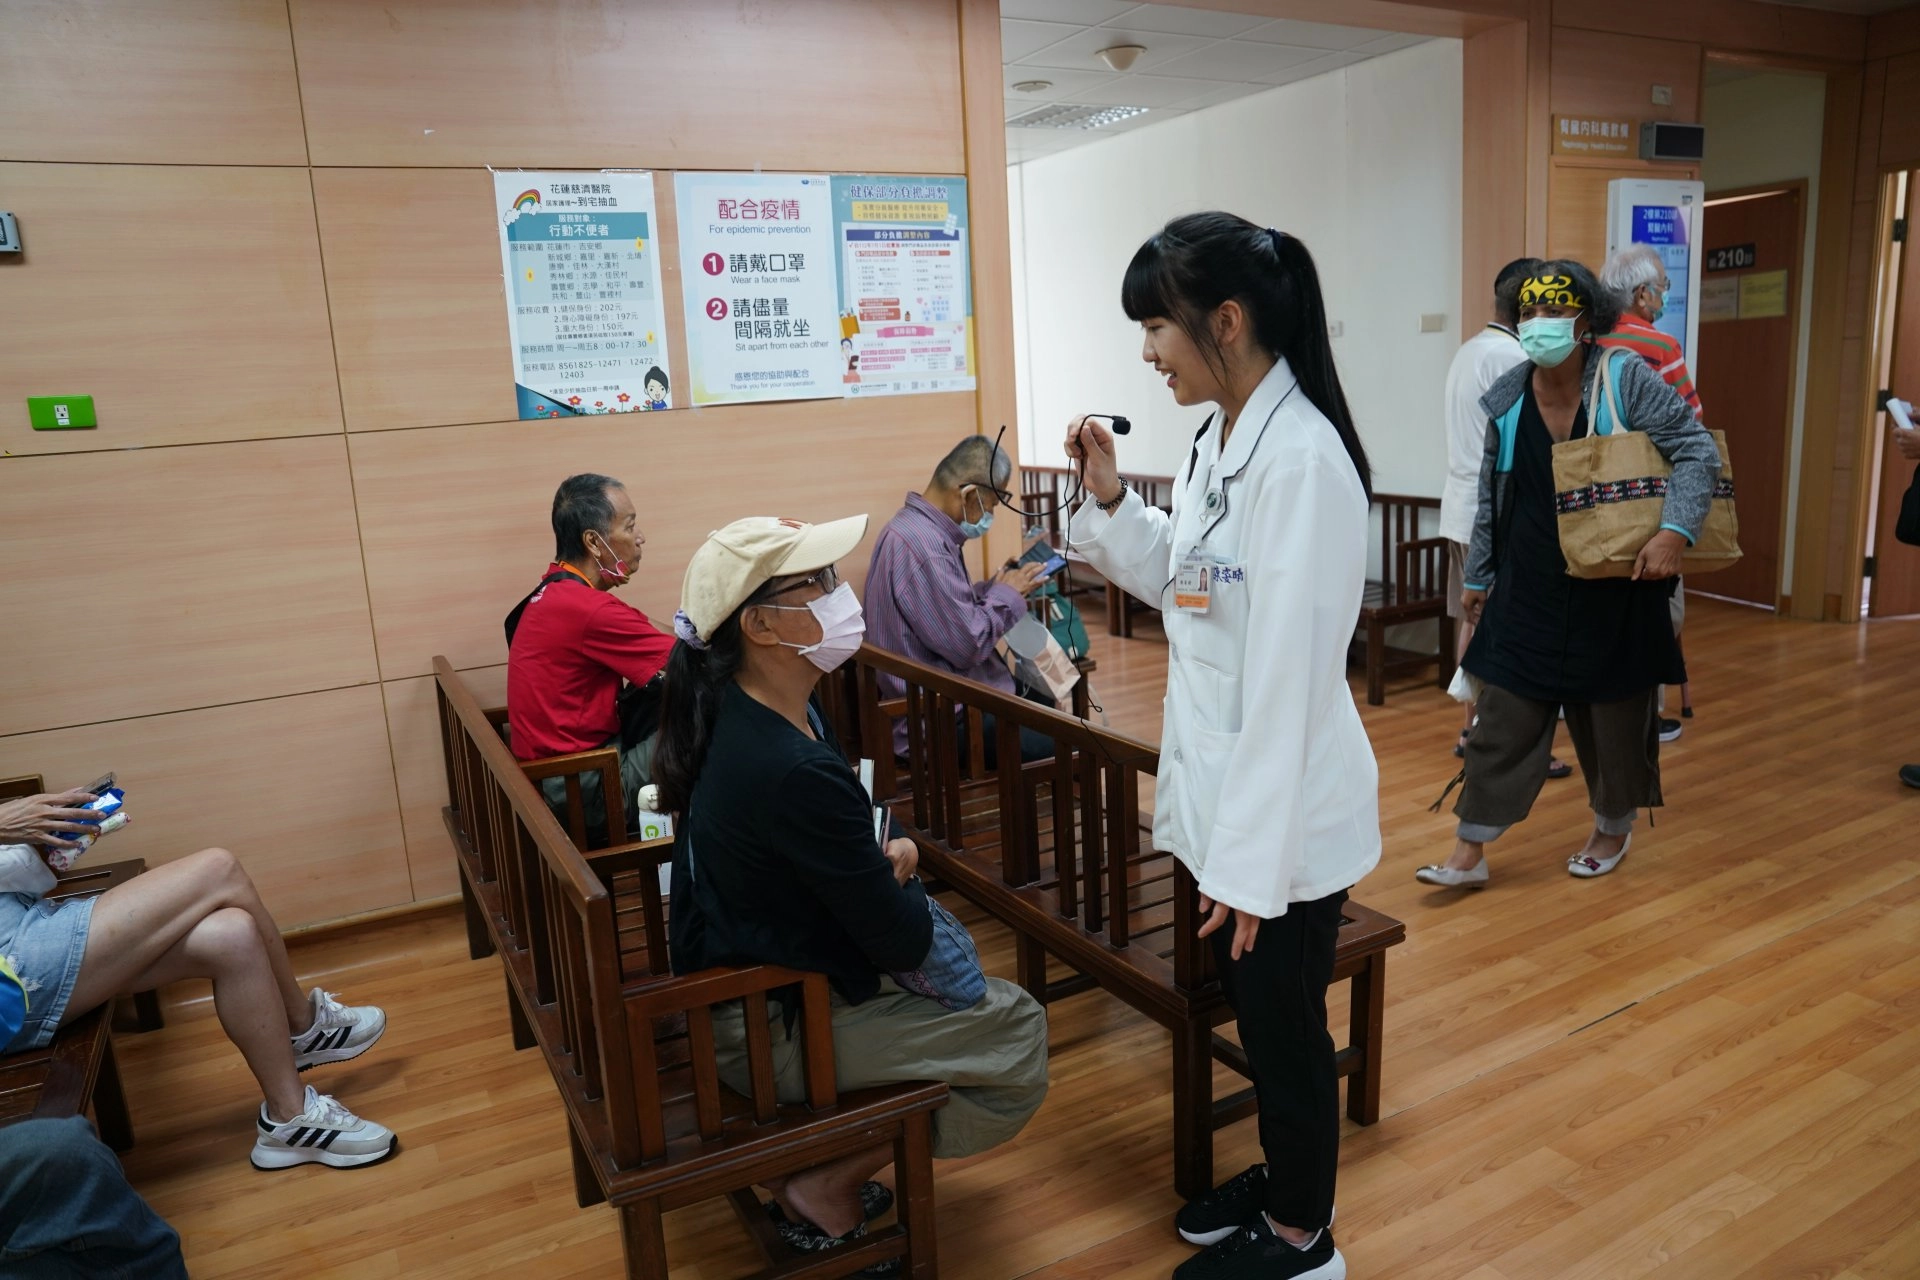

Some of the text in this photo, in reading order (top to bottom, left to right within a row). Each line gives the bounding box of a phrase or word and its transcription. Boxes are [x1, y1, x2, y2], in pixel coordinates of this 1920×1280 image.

[550, 184, 611, 194] 花蓮慈濟醫院
[850, 185, 948, 199] 健保部分負擔調整
[718, 198, 800, 220] 配合疫情
[549, 224, 609, 237] 行動不便者
[709, 225, 811, 236] For epidemic prevention
[708, 255, 717, 273] 1
[729, 253, 806, 273] 請戴口罩
[730, 276, 751, 284] Wear
[761, 275, 778, 284] face
[780, 275, 801, 283] mask
[711, 300, 723, 318] 2
[732, 298, 790, 318] 請儘量
[734, 318, 811, 340] 間隔就坐
[735, 340, 829, 352] Sit apart from each other
[560, 370, 585, 379] 12403
[730, 383, 747, 391] Thank
[749, 383, 760, 391] you
[769, 382, 782, 390] your
